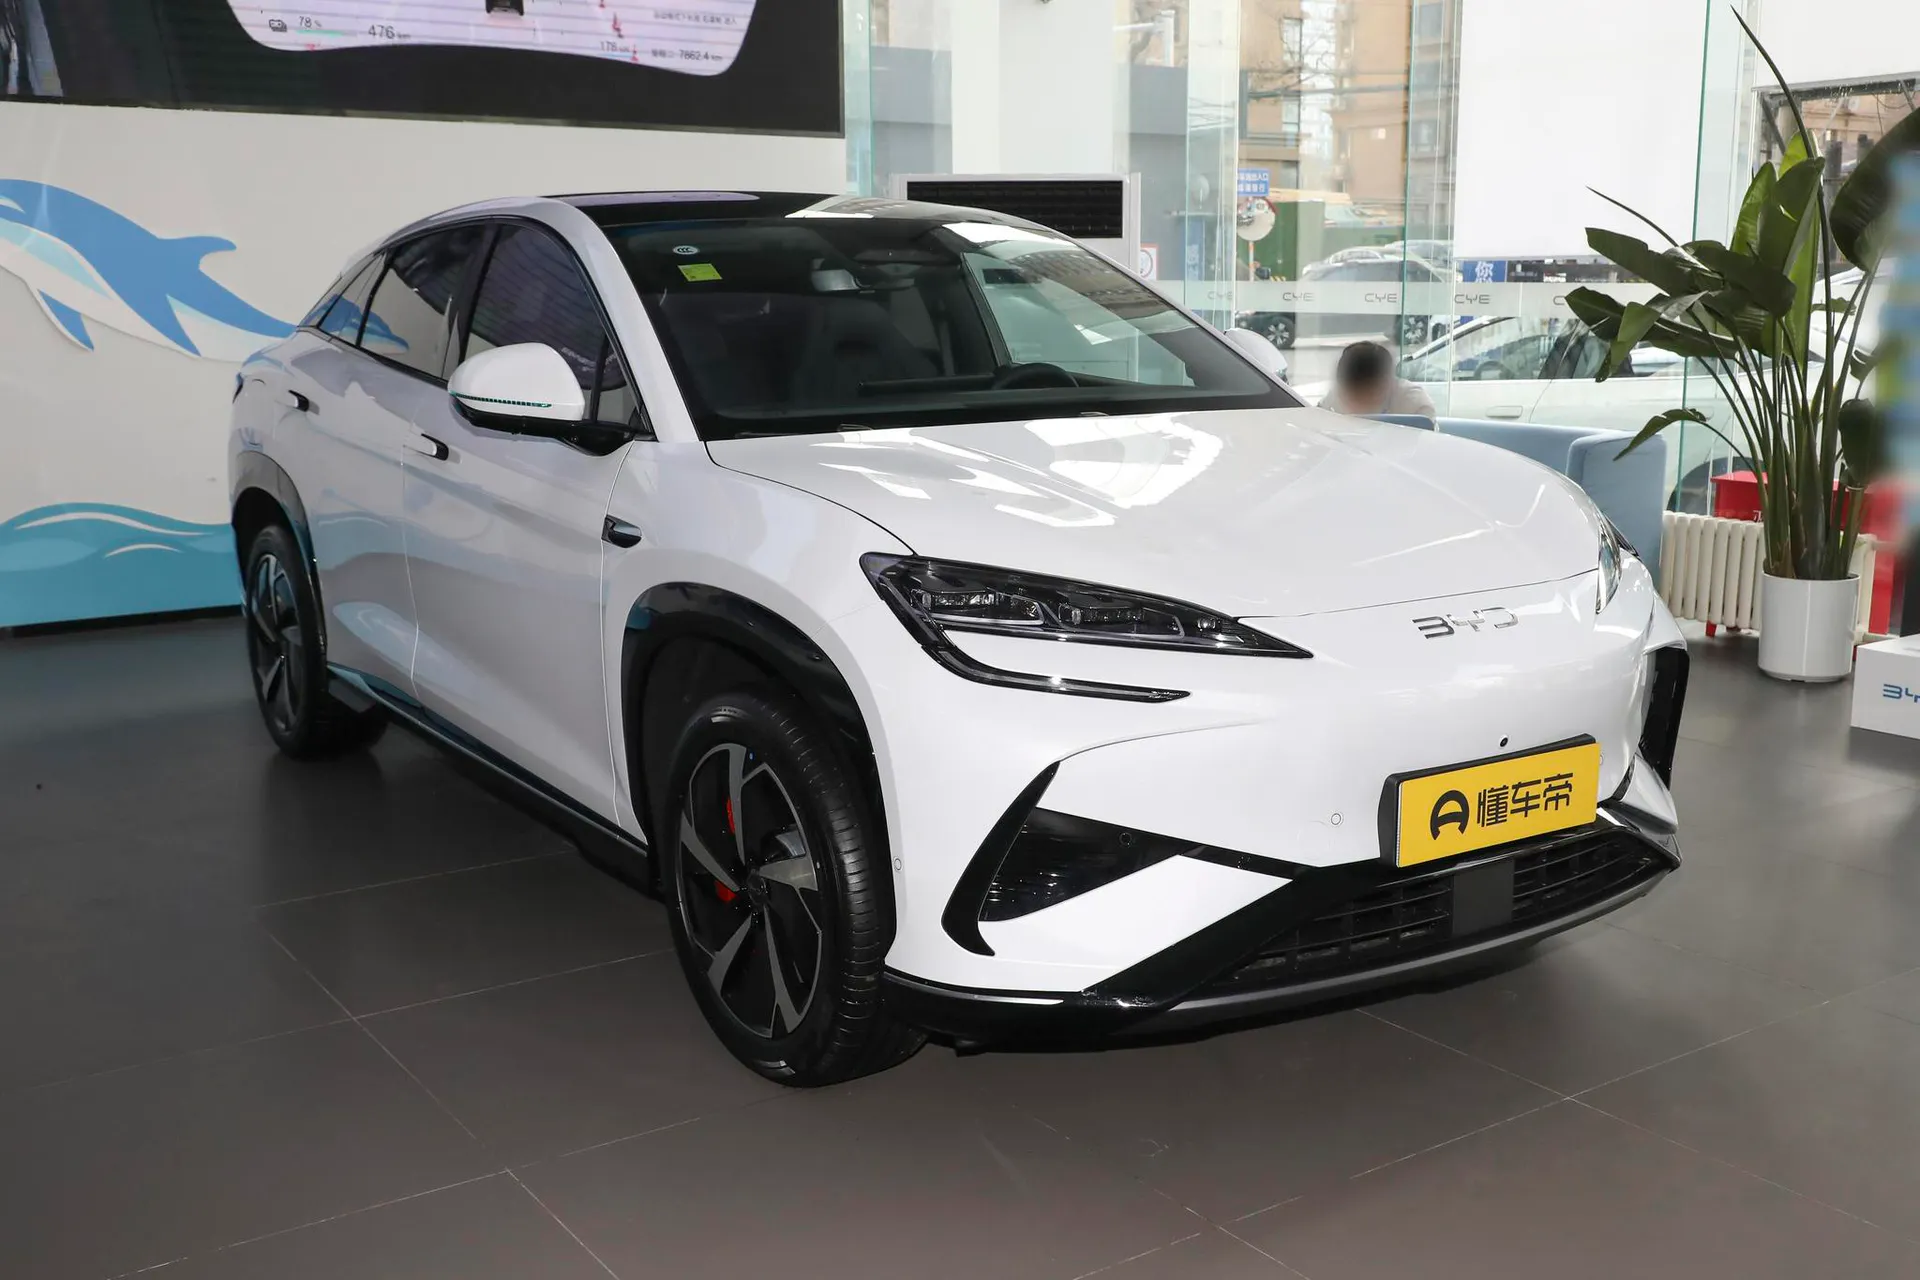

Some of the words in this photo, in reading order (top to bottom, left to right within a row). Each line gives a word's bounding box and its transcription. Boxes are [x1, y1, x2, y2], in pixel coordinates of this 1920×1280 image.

[368, 25, 396, 39] 476
[1412, 607, 1519, 639] BYD
[1477, 773, 1573, 827] 懂车帝
